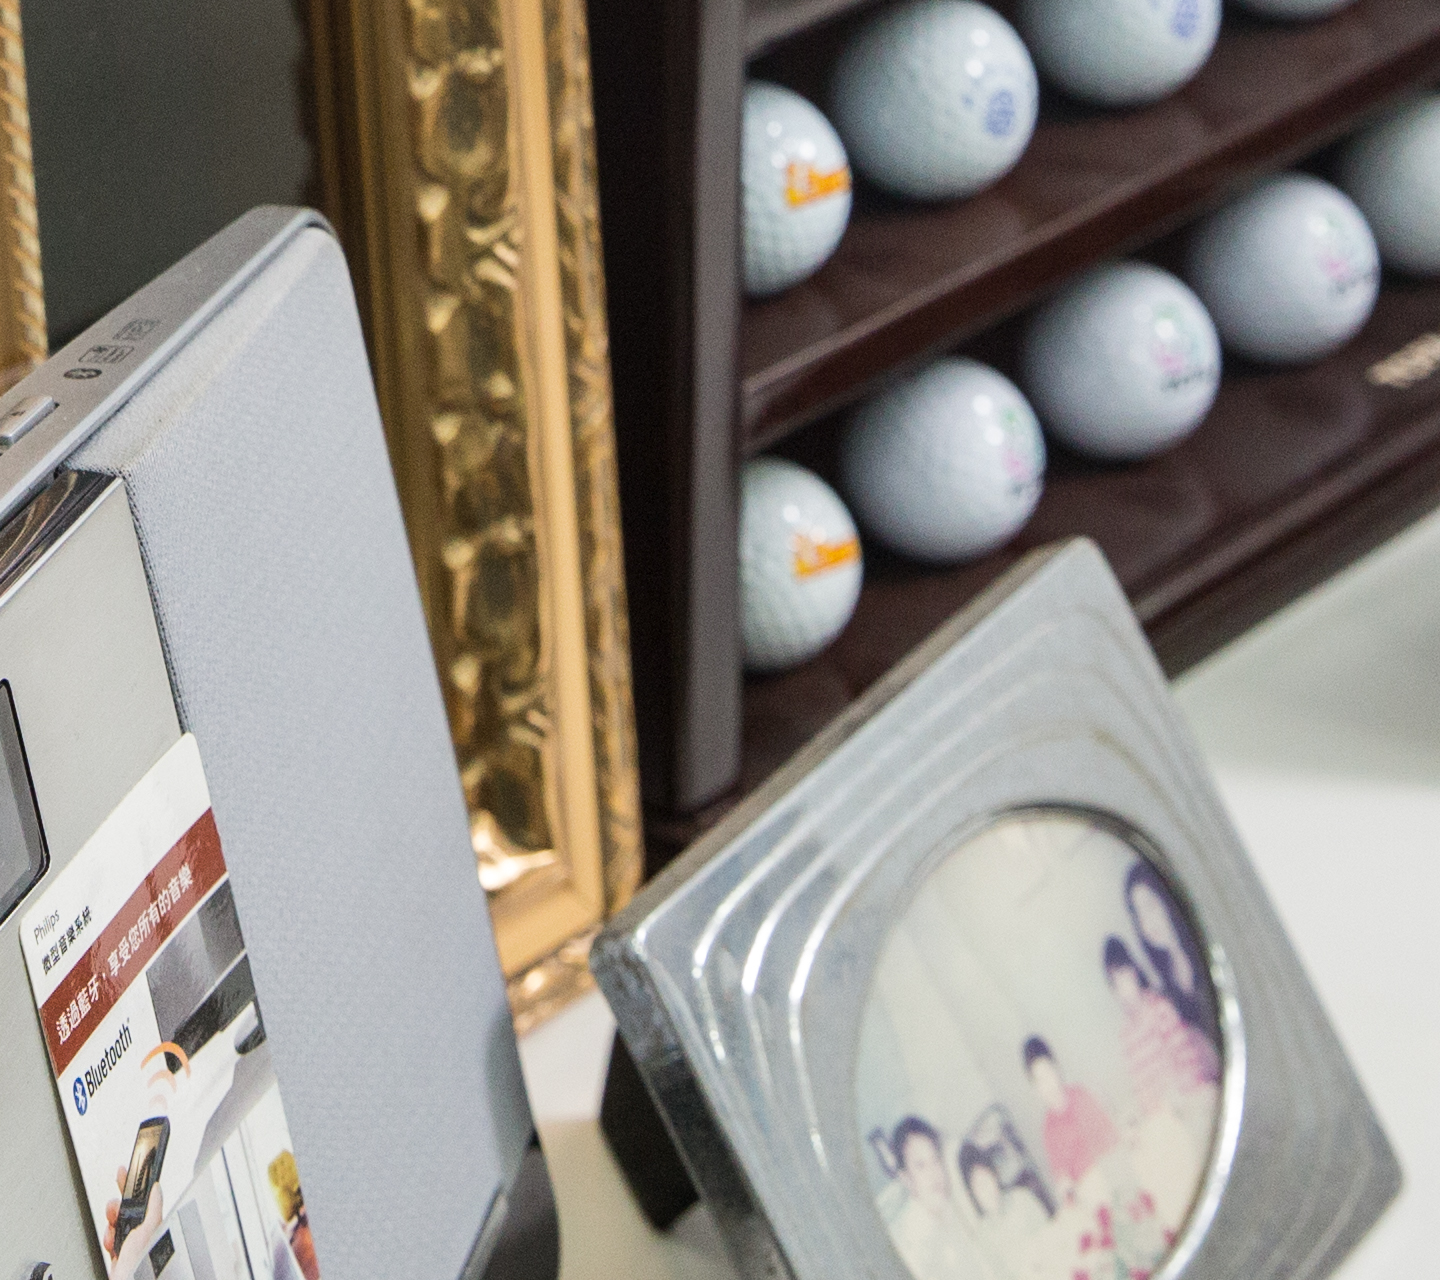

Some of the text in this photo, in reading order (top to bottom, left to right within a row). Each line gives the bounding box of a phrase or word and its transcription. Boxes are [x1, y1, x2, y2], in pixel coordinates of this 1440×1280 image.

[34, 909, 60, 944] Philips
[42, 905, 93, 975] 微型音樂系統
[84, 1022, 132, 1099] Bluetooth
